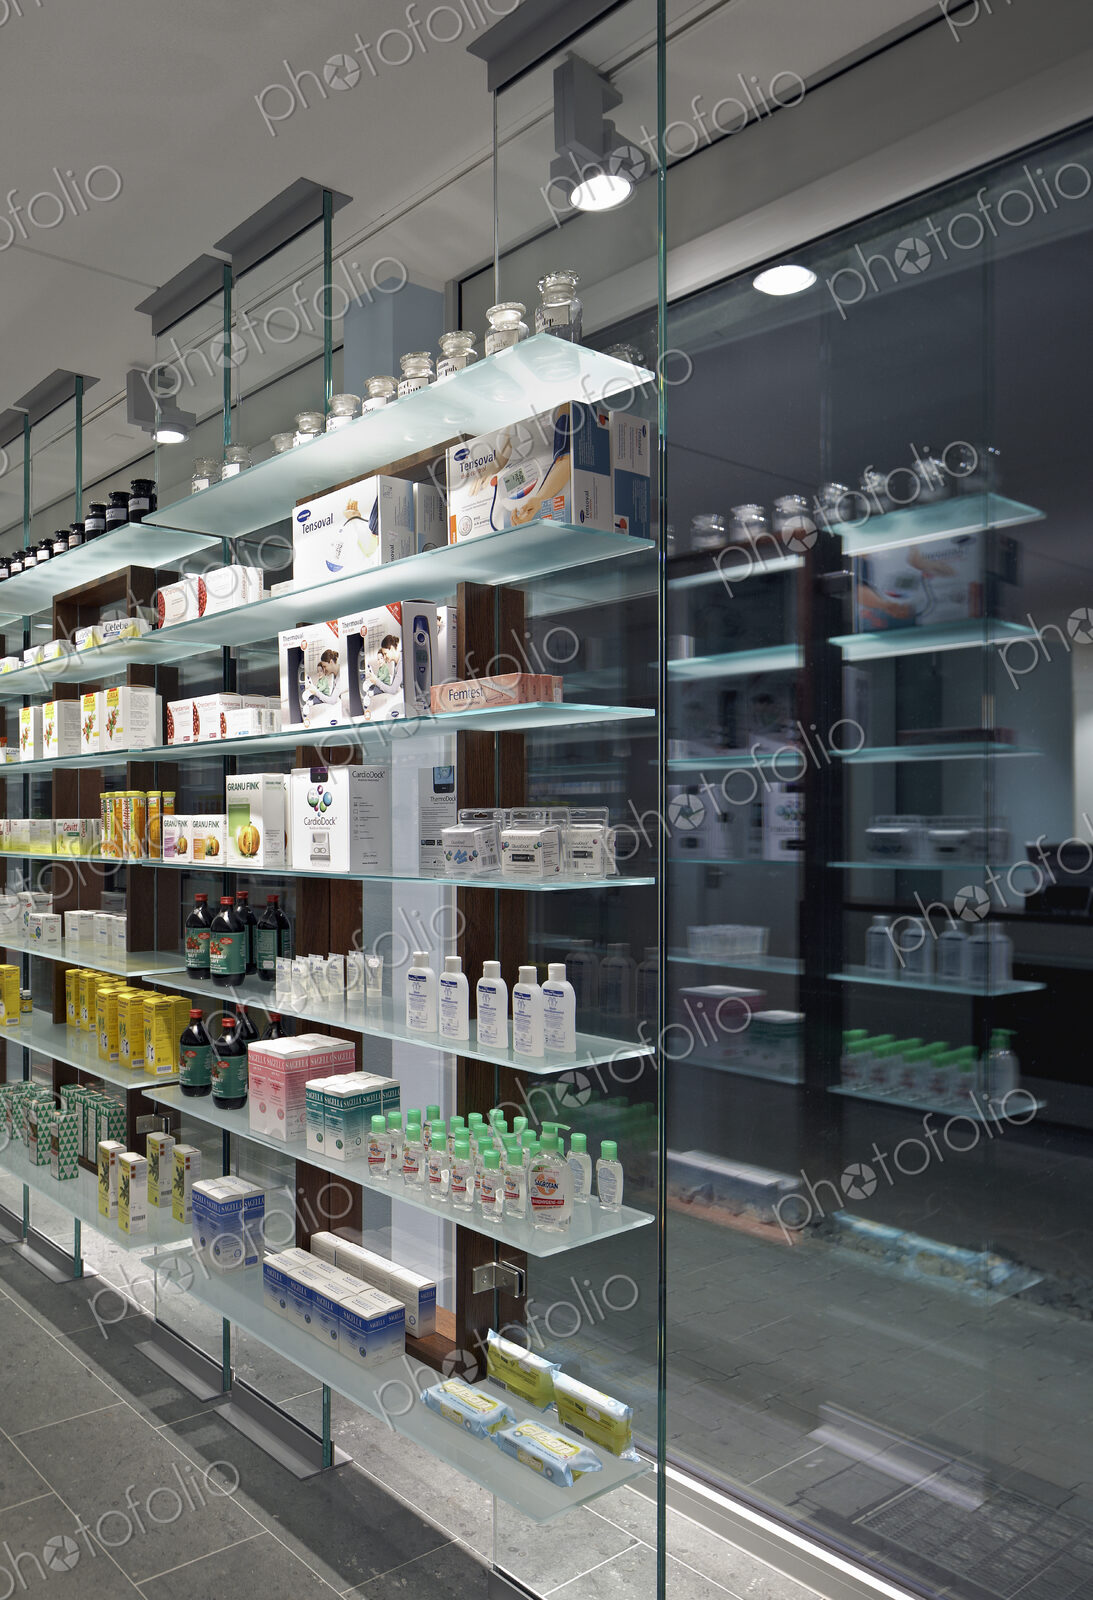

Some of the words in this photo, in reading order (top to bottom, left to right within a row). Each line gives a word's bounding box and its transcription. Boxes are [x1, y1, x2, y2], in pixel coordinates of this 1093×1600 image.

[459, 449, 496, 472] Tensoval
[302, 513, 334, 534] Tensoval
[449, 687, 484, 701] Femtest
[352, 770, 385, 779] CardioDock
[227, 782, 245, 791] GRANU
[246, 782, 259, 790] FINK
[303, 816, 337, 826] CardioDock
[63, 822, 78, 832] Cevitt
[285, 1059, 309, 1070] SAGELLA
